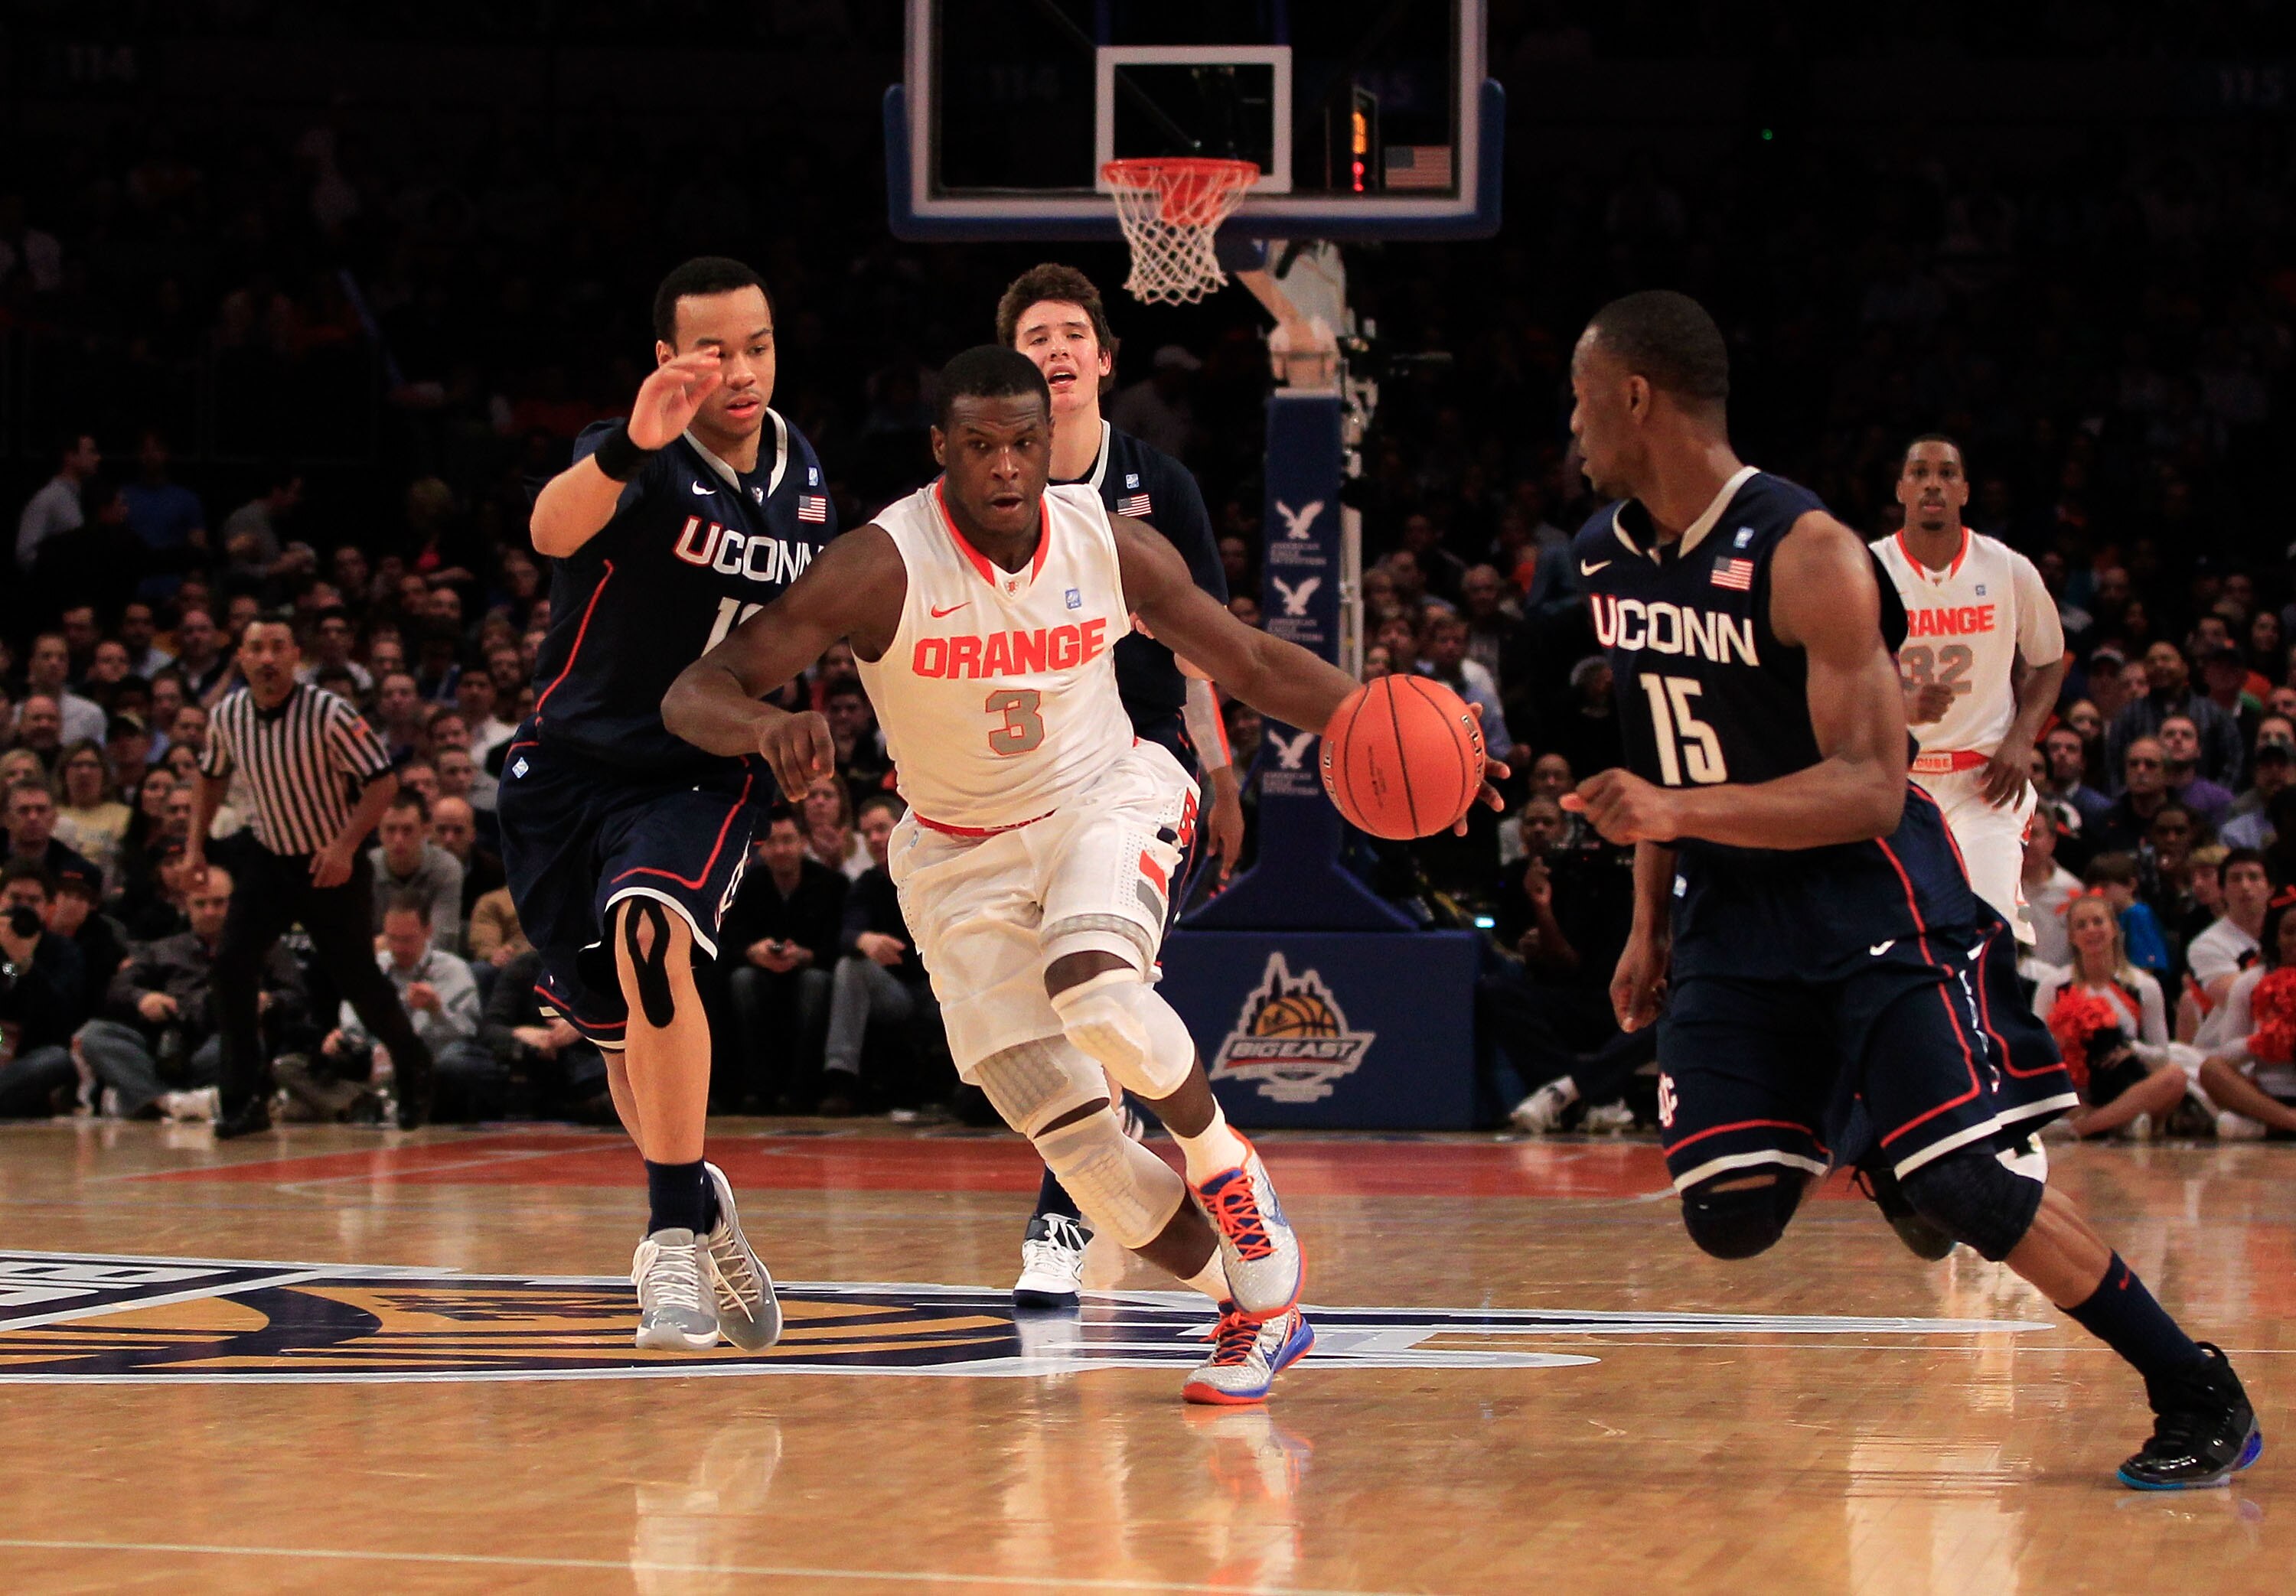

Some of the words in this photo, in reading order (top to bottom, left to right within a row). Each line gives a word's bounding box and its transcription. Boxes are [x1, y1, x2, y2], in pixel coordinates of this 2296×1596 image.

[700, 597, 764, 657] 1
[912, 617, 1107, 679] ORANGE
[1590, 593, 1760, 666] UCONN
[1900, 645, 1972, 695] 32
[985, 689, 1045, 755] 3
[1639, 673, 1728, 786] 15
